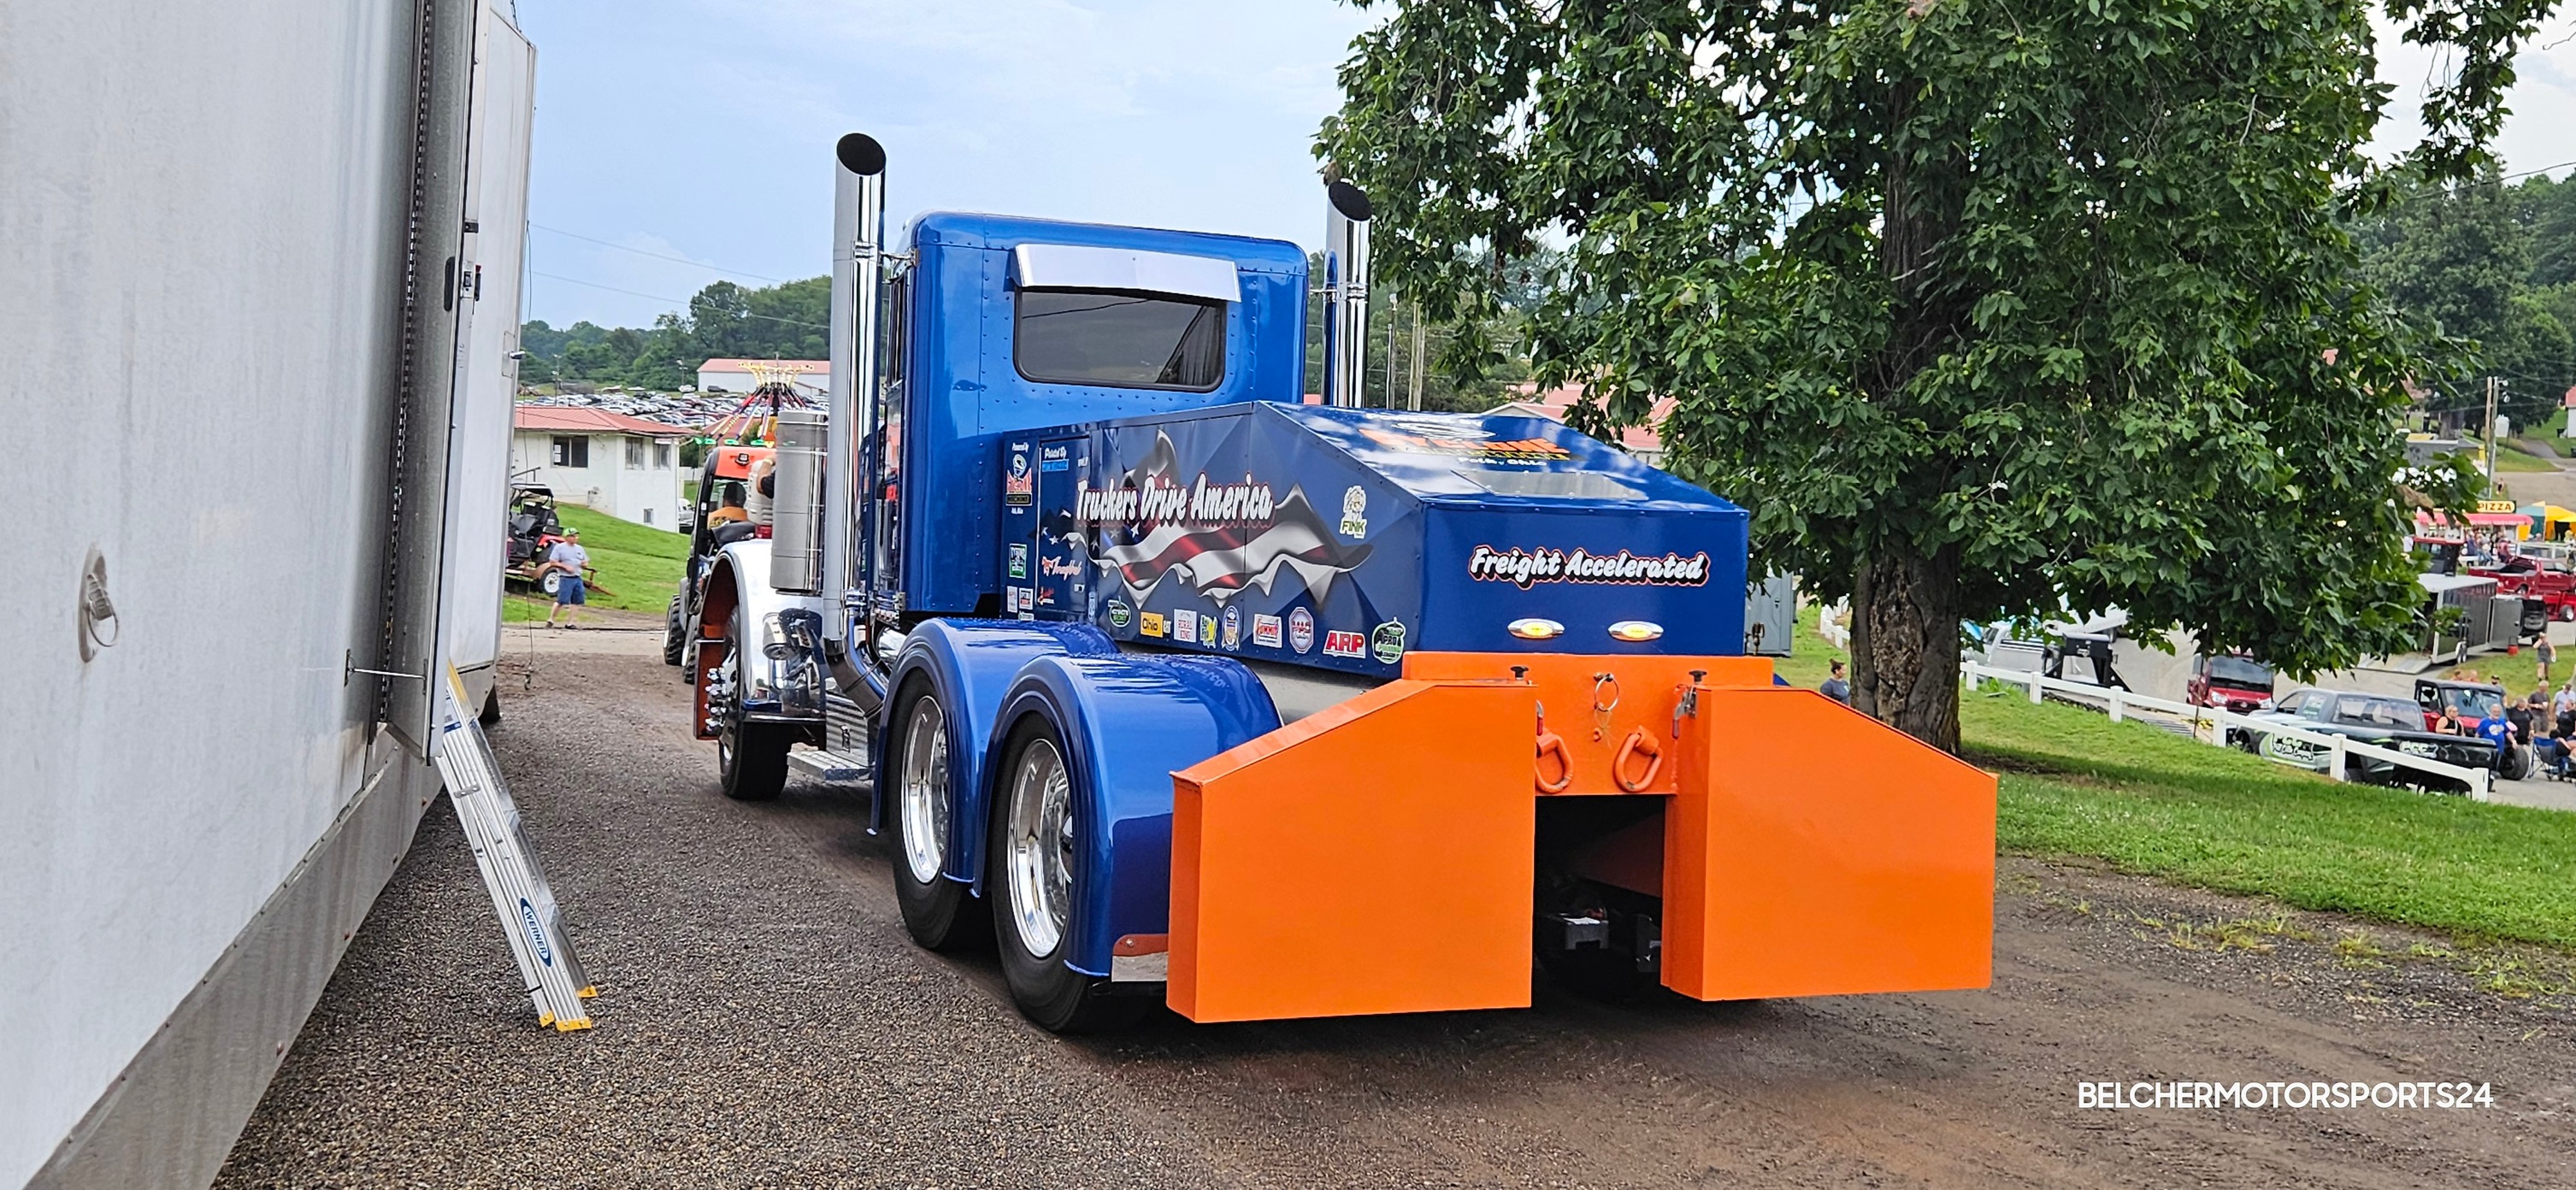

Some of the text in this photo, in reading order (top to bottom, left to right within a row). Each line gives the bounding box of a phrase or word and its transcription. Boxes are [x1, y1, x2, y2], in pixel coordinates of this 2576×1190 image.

[1076, 478, 1138, 521] Truckers
[1140, 475, 1188, 521] Drive
[1190, 472, 1273, 521] America
[2477, 502, 2512, 511] PIZZA
[1341, 520, 1365, 533] FINK
[1470, 546, 1706, 585] Freight Accelerated
[1141, 617, 1158, 632] Ohio
[1325, 632, 1365, 653] ARP
[525, 910, 547, 954] WERNER
